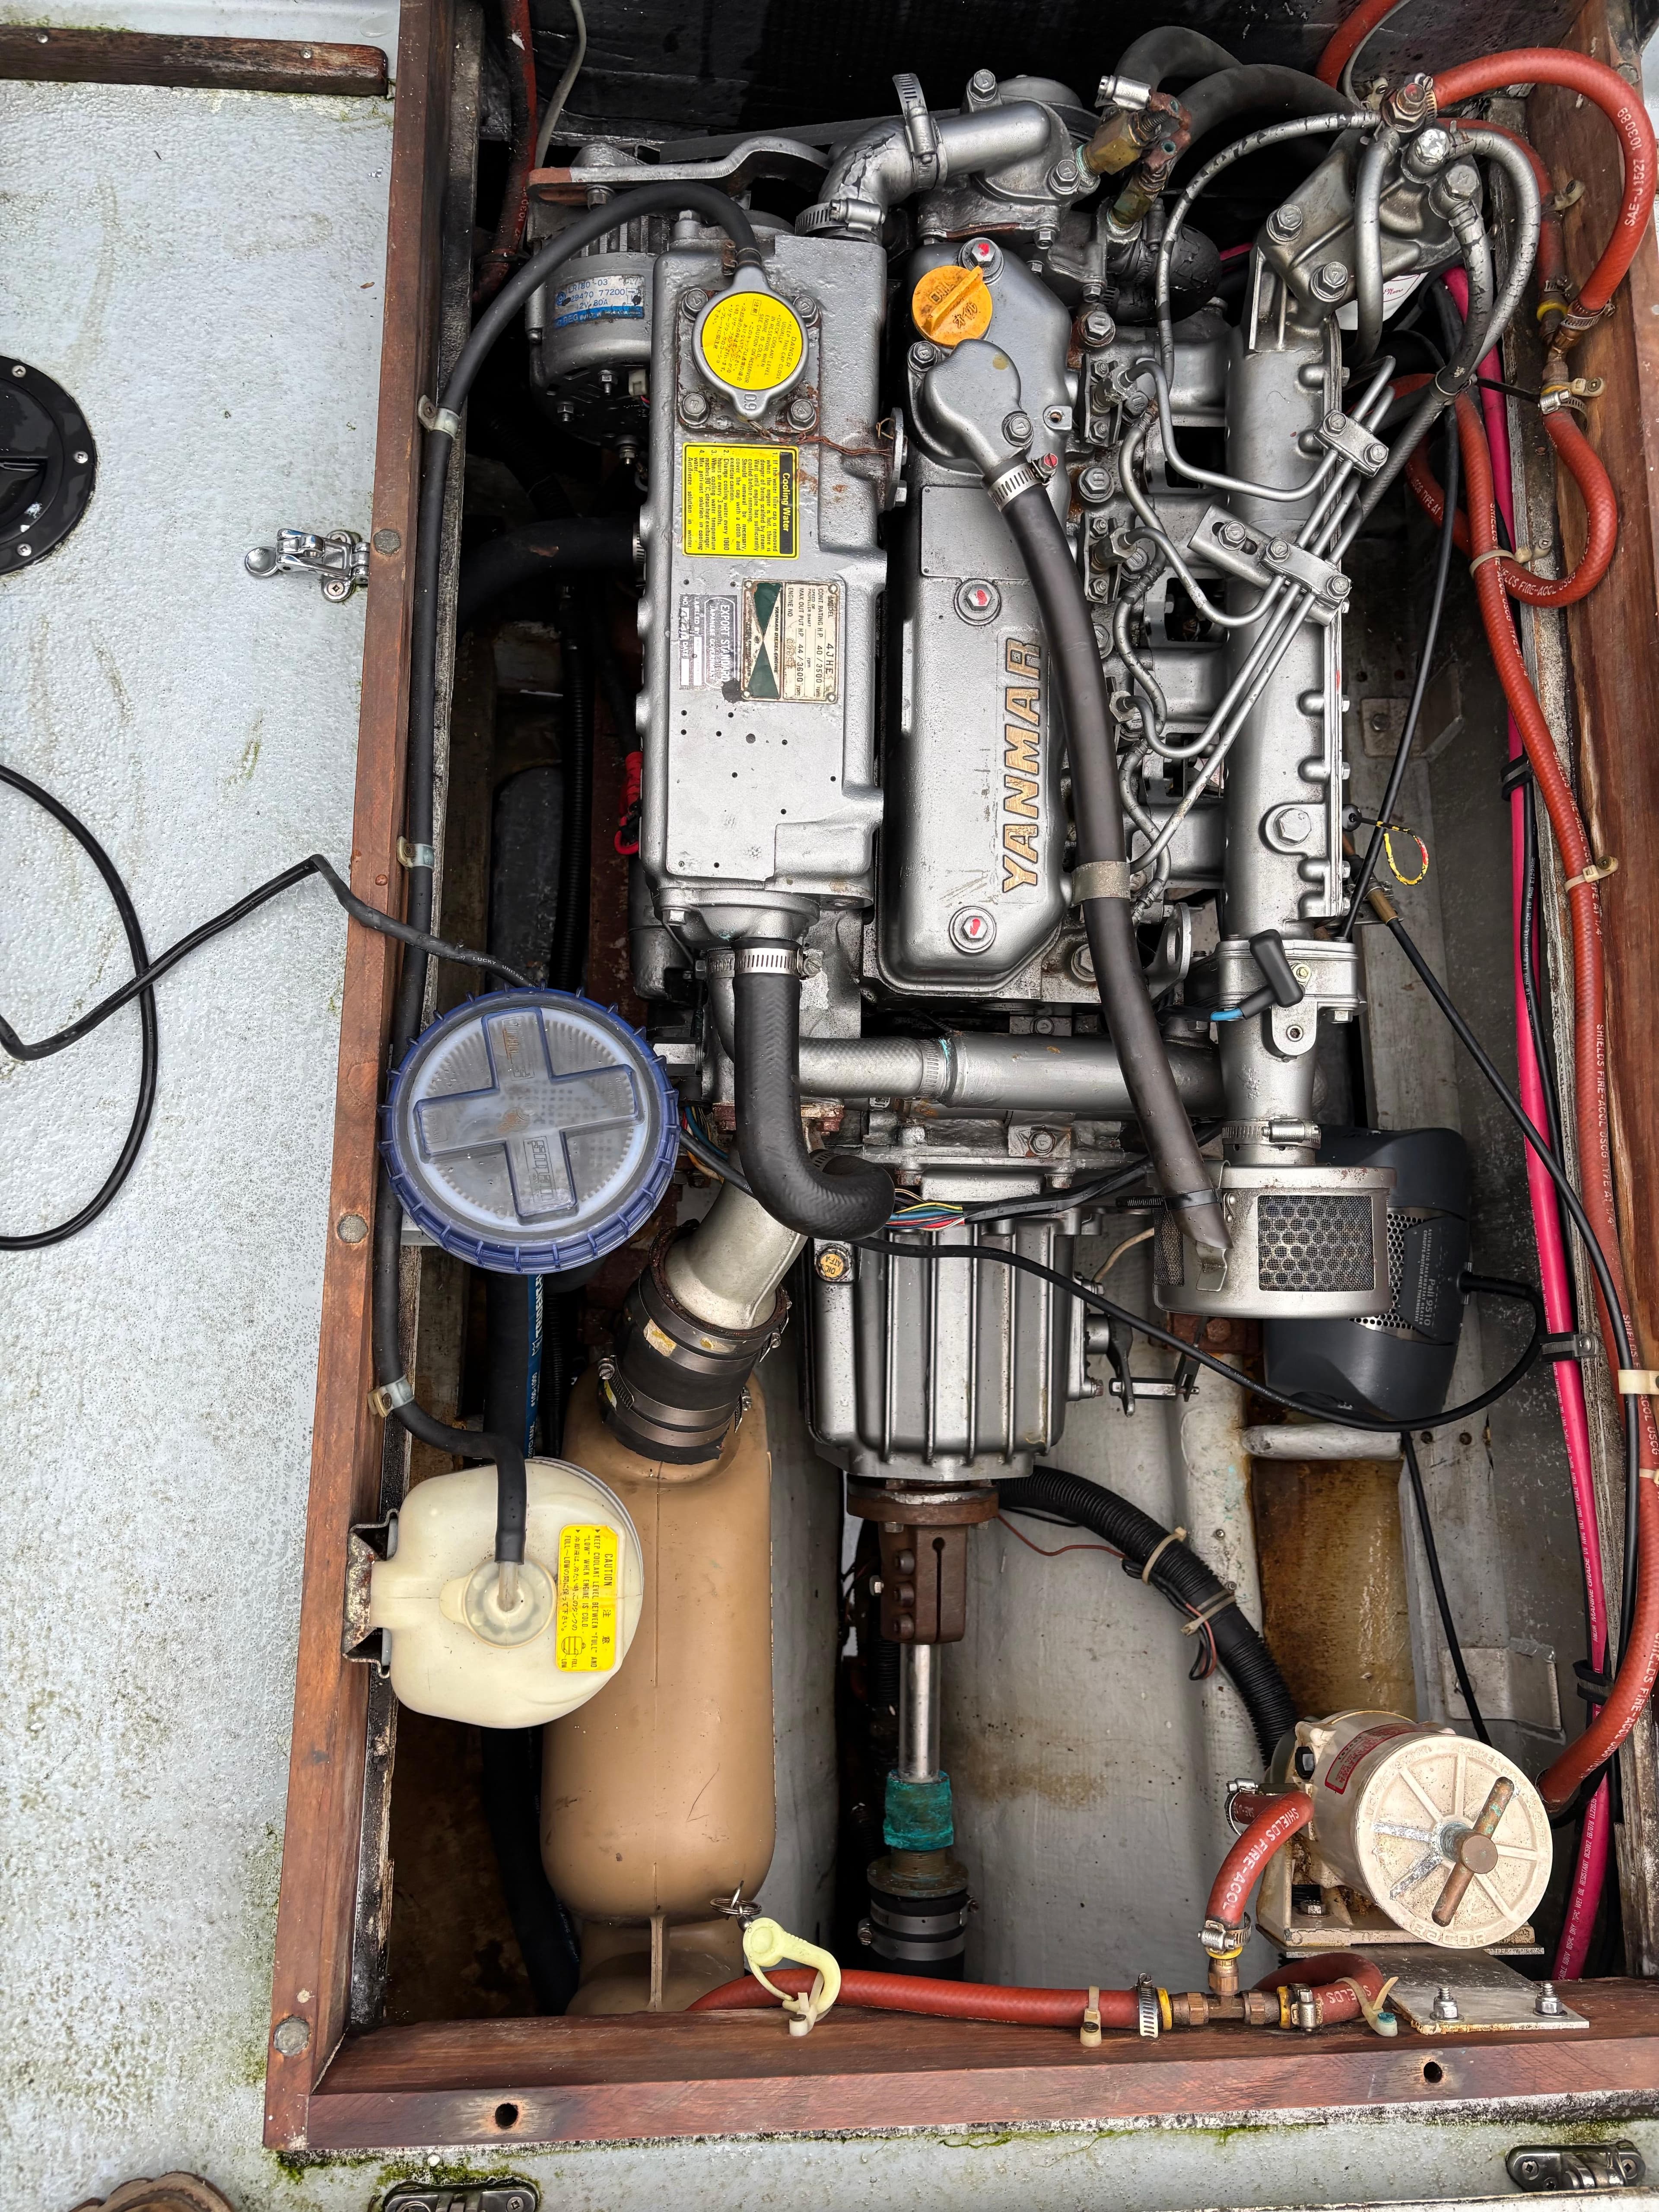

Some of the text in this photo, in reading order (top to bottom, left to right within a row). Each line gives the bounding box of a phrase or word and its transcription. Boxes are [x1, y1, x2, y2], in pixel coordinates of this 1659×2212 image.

[785, 337, 797, 367] DANGER
[720, 604, 730, 636] EXPORT
[1003, 638, 1039, 893] YANMAR
[472, 956, 497, 965] LUCKY
[1596, 1024, 1611, 1187] SHIELDS FIRE-ACOL USCG TYPE
[826, 1265, 836, 1274] OIL
[1424, 1279, 1435, 1325] Pall 9510
[604, 1554, 612, 1586] CAUTION
[1588, 1589, 1596, 1622] MARINE
[1265, 1807, 1300, 1841] SHIELDS
[1222, 1838, 1269, 1911] FIRE-ACOL
[1580, 1859, 1589, 1886] RESISTANT
[1326, 1985, 1371, 2004] SELDS
